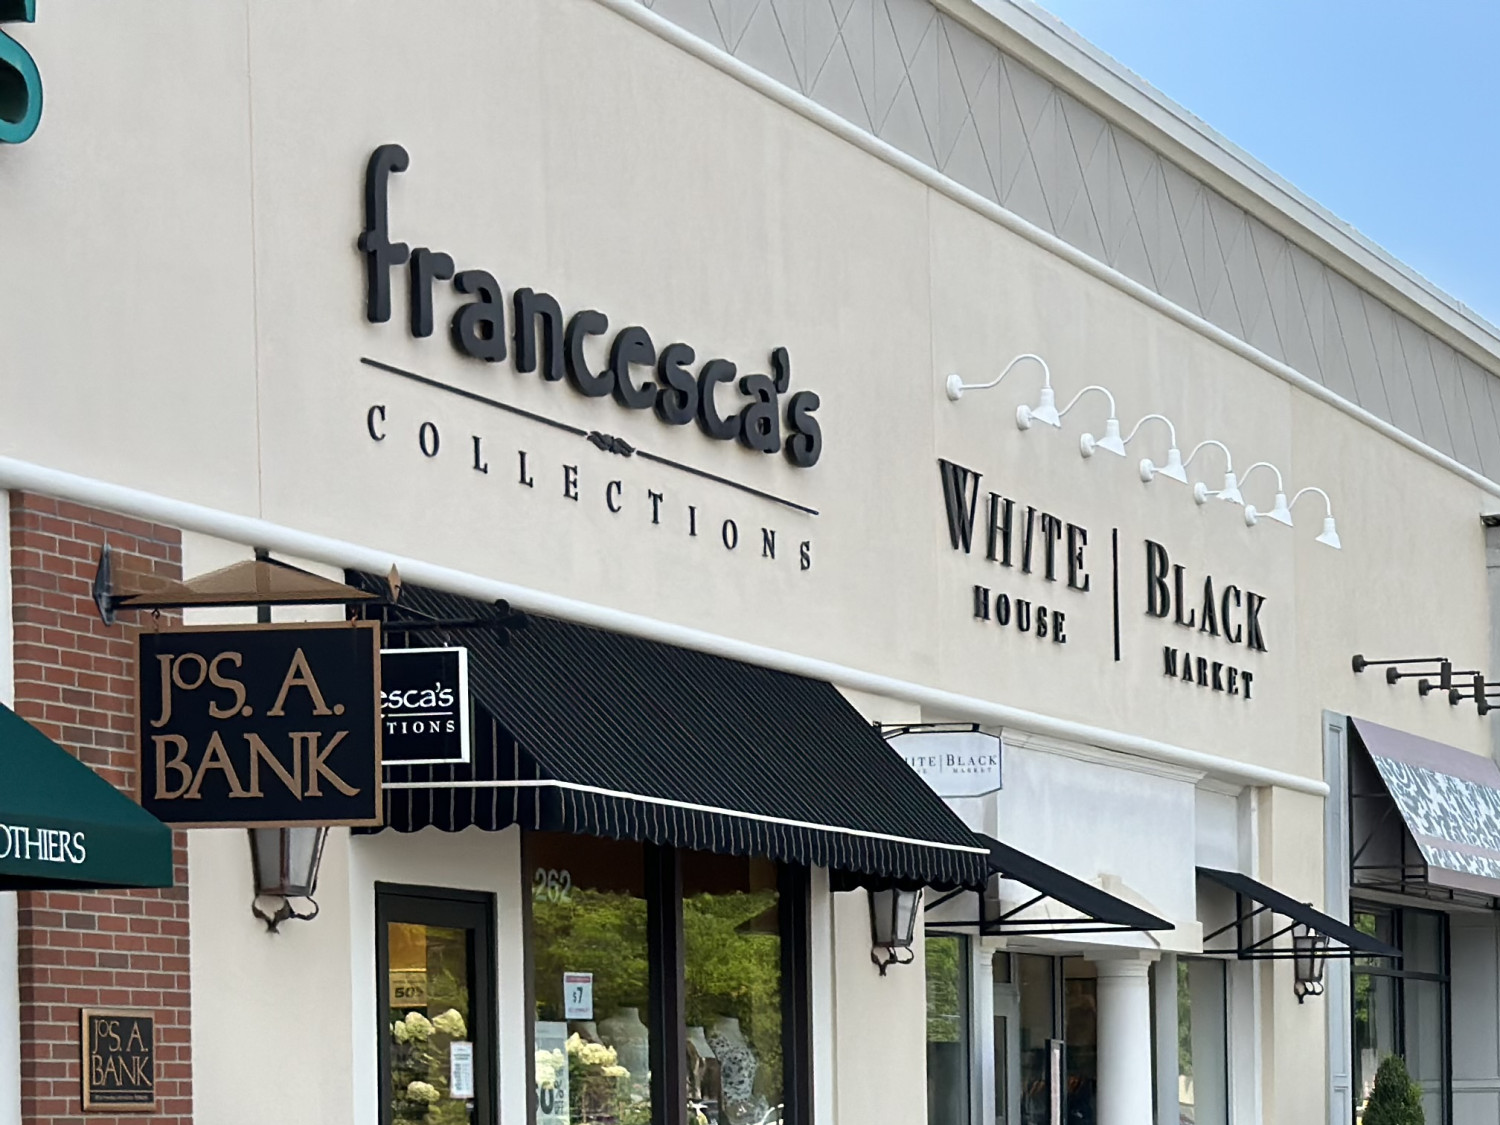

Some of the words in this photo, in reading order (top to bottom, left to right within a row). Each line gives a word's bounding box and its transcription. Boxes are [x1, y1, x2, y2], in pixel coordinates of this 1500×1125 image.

[357, 144, 821, 468] francesca's
[367, 405, 812, 571] COLLECTIONS
[938, 458, 1090, 592] WHITE
[973, 585, 1067, 644] HOUSE
[1144, 539, 1268, 653] BLACK
[267, 647, 345, 717] A.
[1163, 646, 1254, 699] MARKET
[151, 730, 362, 801] BANK
[946, 753, 997, 766] BLACK
[0, 823, 86, 864] OTHIERS
[535, 867, 572, 900] 262
[126, 1021, 149, 1052] A.
[91, 1055, 152, 1087] BANK
